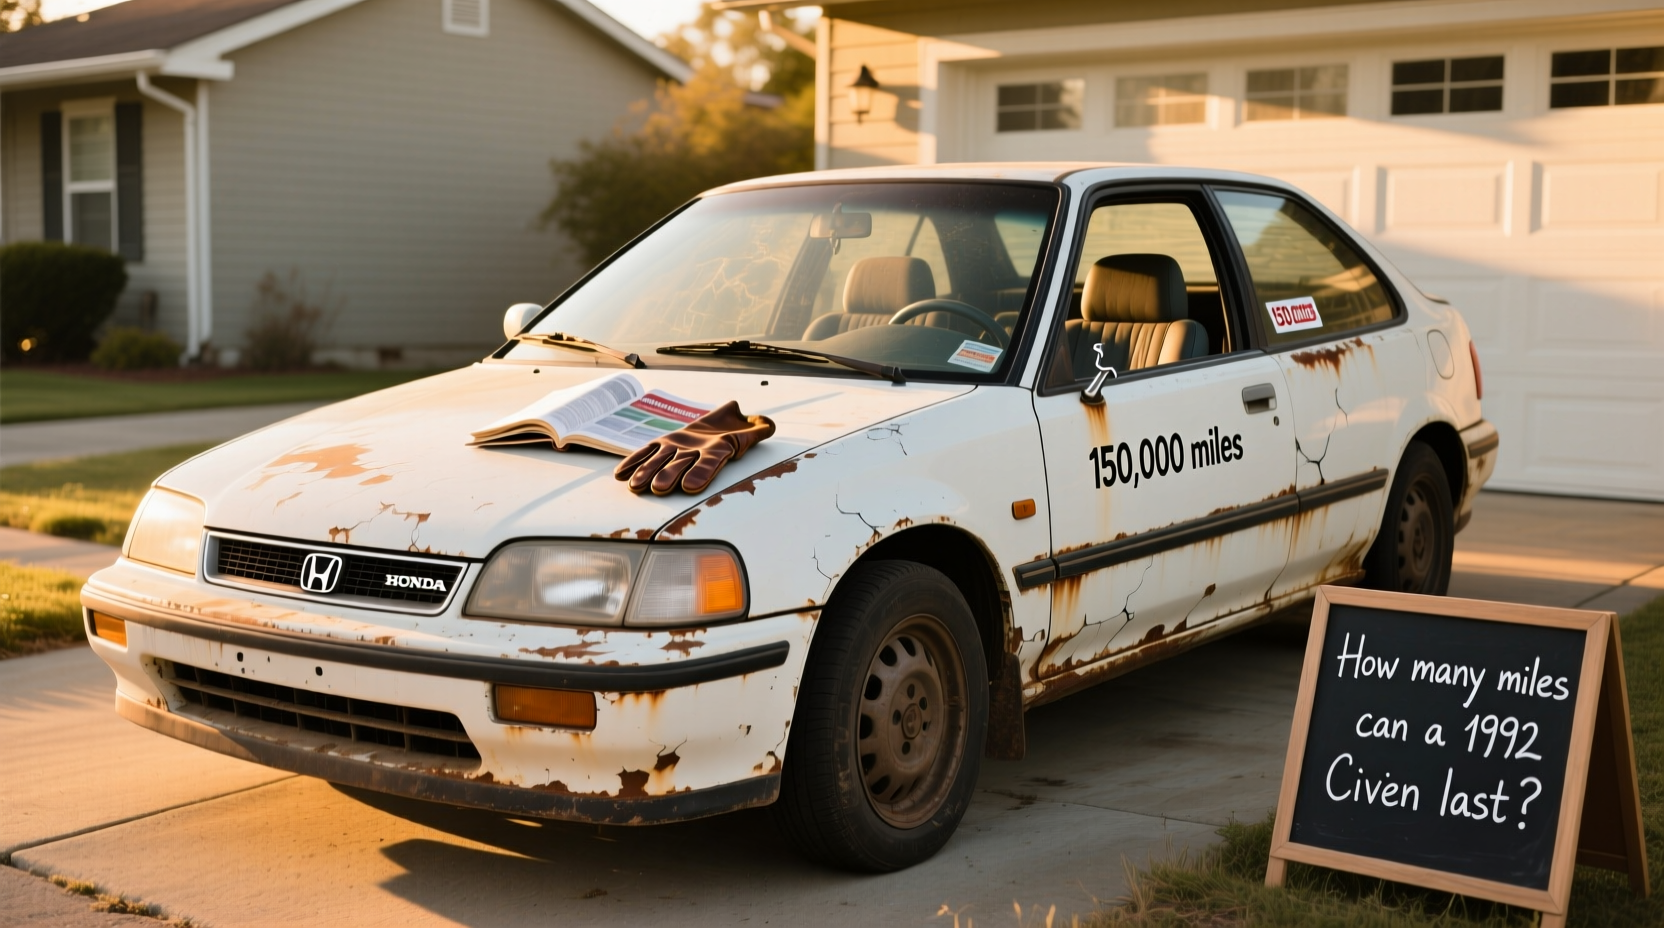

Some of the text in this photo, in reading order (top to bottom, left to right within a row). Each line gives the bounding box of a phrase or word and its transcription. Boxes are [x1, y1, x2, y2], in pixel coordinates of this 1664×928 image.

[1089, 426, 1243, 489] 150,000 miles
[385, 574, 446, 591] HONDA
[1337, 632, 1569, 708] How many miles
[1356, 713, 1542, 760] can a 1992
